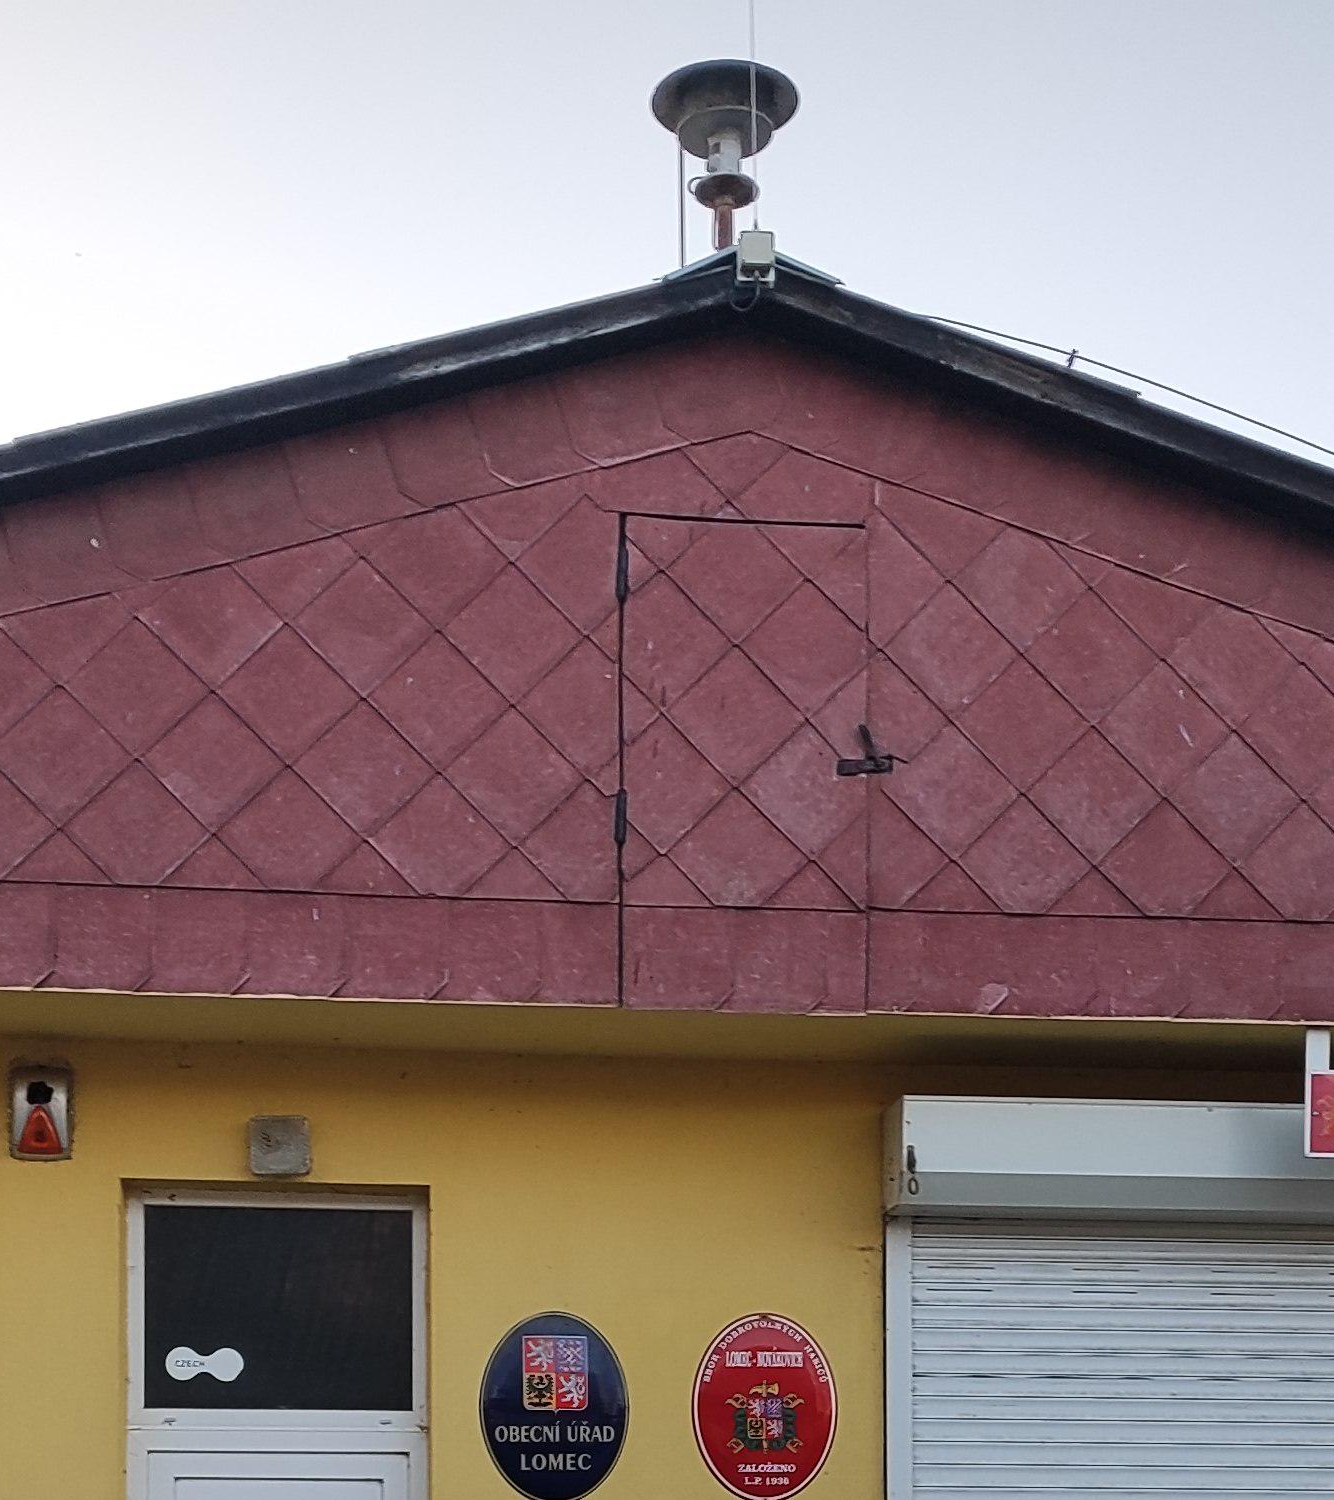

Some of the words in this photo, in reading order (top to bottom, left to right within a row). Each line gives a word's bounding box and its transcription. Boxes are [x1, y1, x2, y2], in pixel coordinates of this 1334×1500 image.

[494, 1421, 560, 1443] OBECNÍ
[567, 1421, 615, 1443] ÚŘAD
[520, 1453, 592, 1471] LOMEC
[737, 1461, 797, 1473] ZALOŽENO
